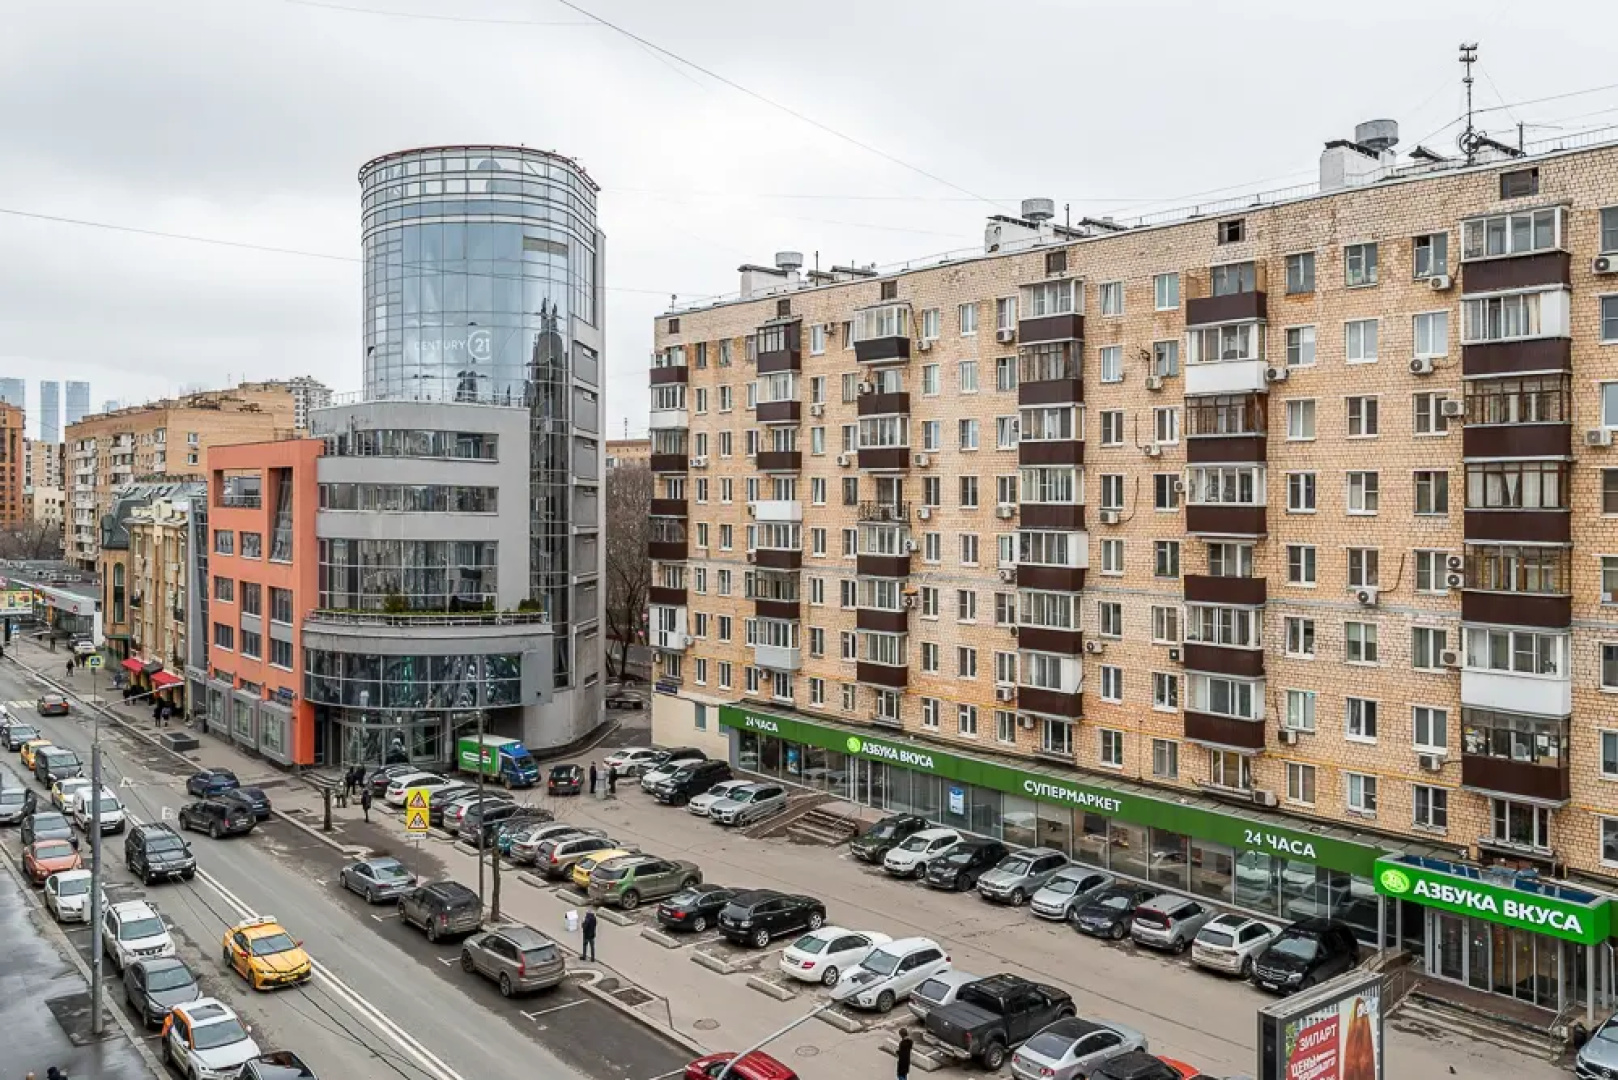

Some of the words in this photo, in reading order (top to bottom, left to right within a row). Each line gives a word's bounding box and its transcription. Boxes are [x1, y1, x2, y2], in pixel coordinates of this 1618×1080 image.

[414, 339, 466, 351] CENTURY
[475, 337, 490, 352] 21
[744, 715, 754, 727] 24
[754, 718, 779, 733] ЧАСА
[861, 741, 900, 761] АЗБУКА
[900, 749, 935, 769] ВКУСА
[1023, 779, 1122, 812] СУПЕРМАРКЕТ
[1244, 829, 1262, 846] 24
[1265, 833, 1317, 859] ЧАСА
[1413, 879, 1499, 914] АЗБУКА
[1503, 898, 1584, 935] ВКУСА
[1298, 1022, 1337, 1052] ЗИЛАРТ
